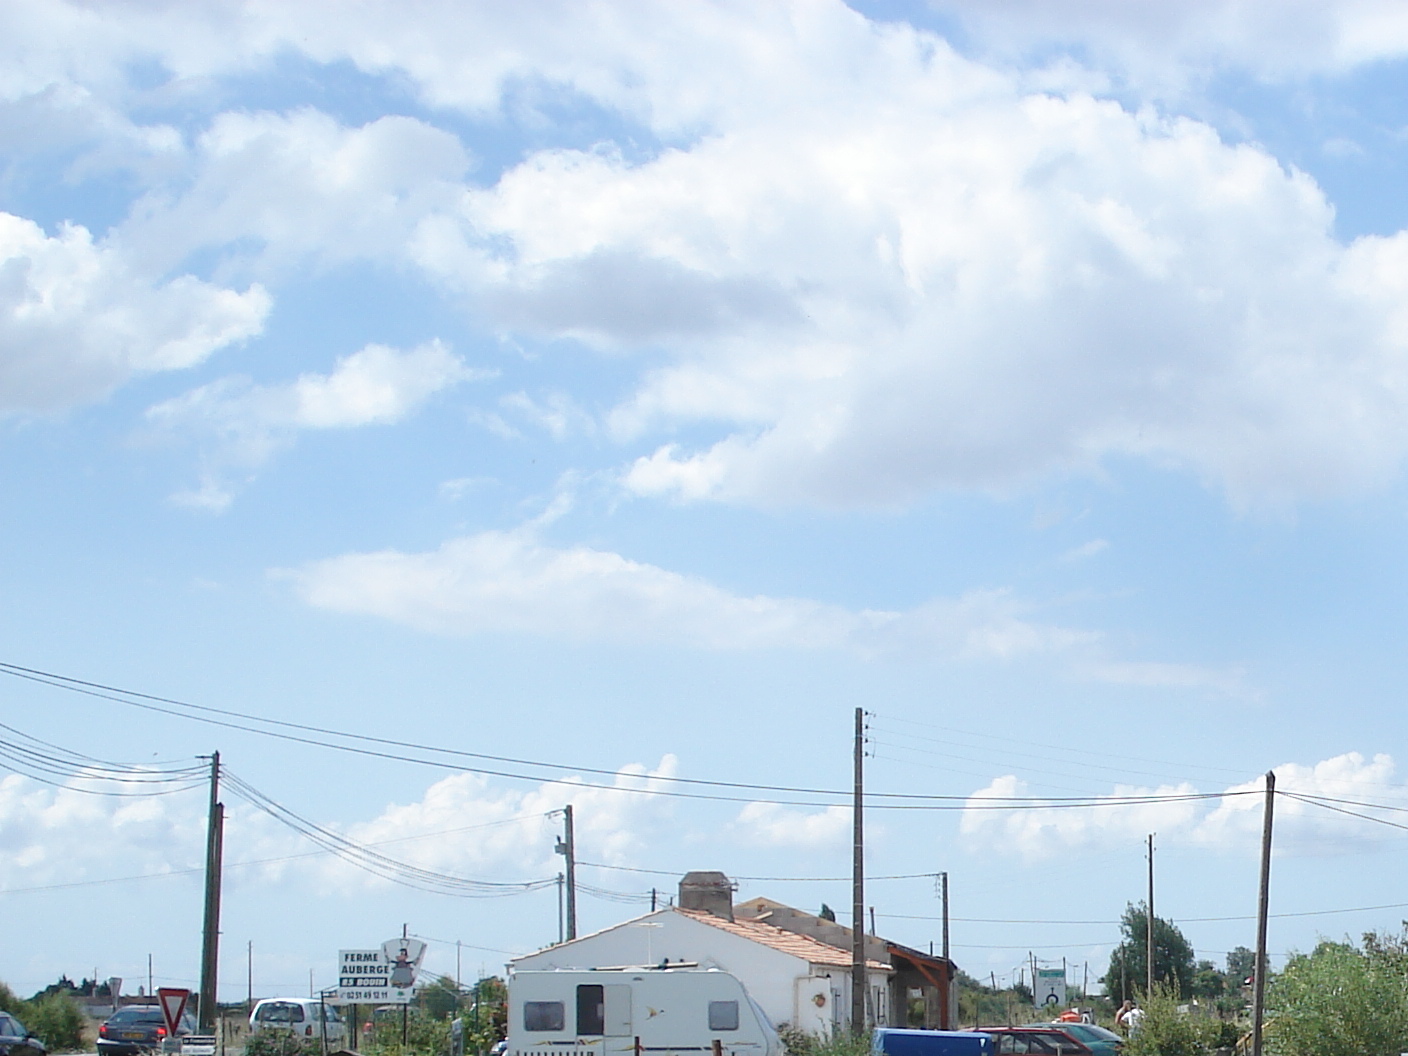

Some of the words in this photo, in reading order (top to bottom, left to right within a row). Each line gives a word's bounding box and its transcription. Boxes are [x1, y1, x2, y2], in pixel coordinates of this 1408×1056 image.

[344, 953, 378, 962] FERME
[341, 965, 389, 974] AUBERGE
[346, 991, 354, 999] 02
[355, 991, 362, 999] 51
